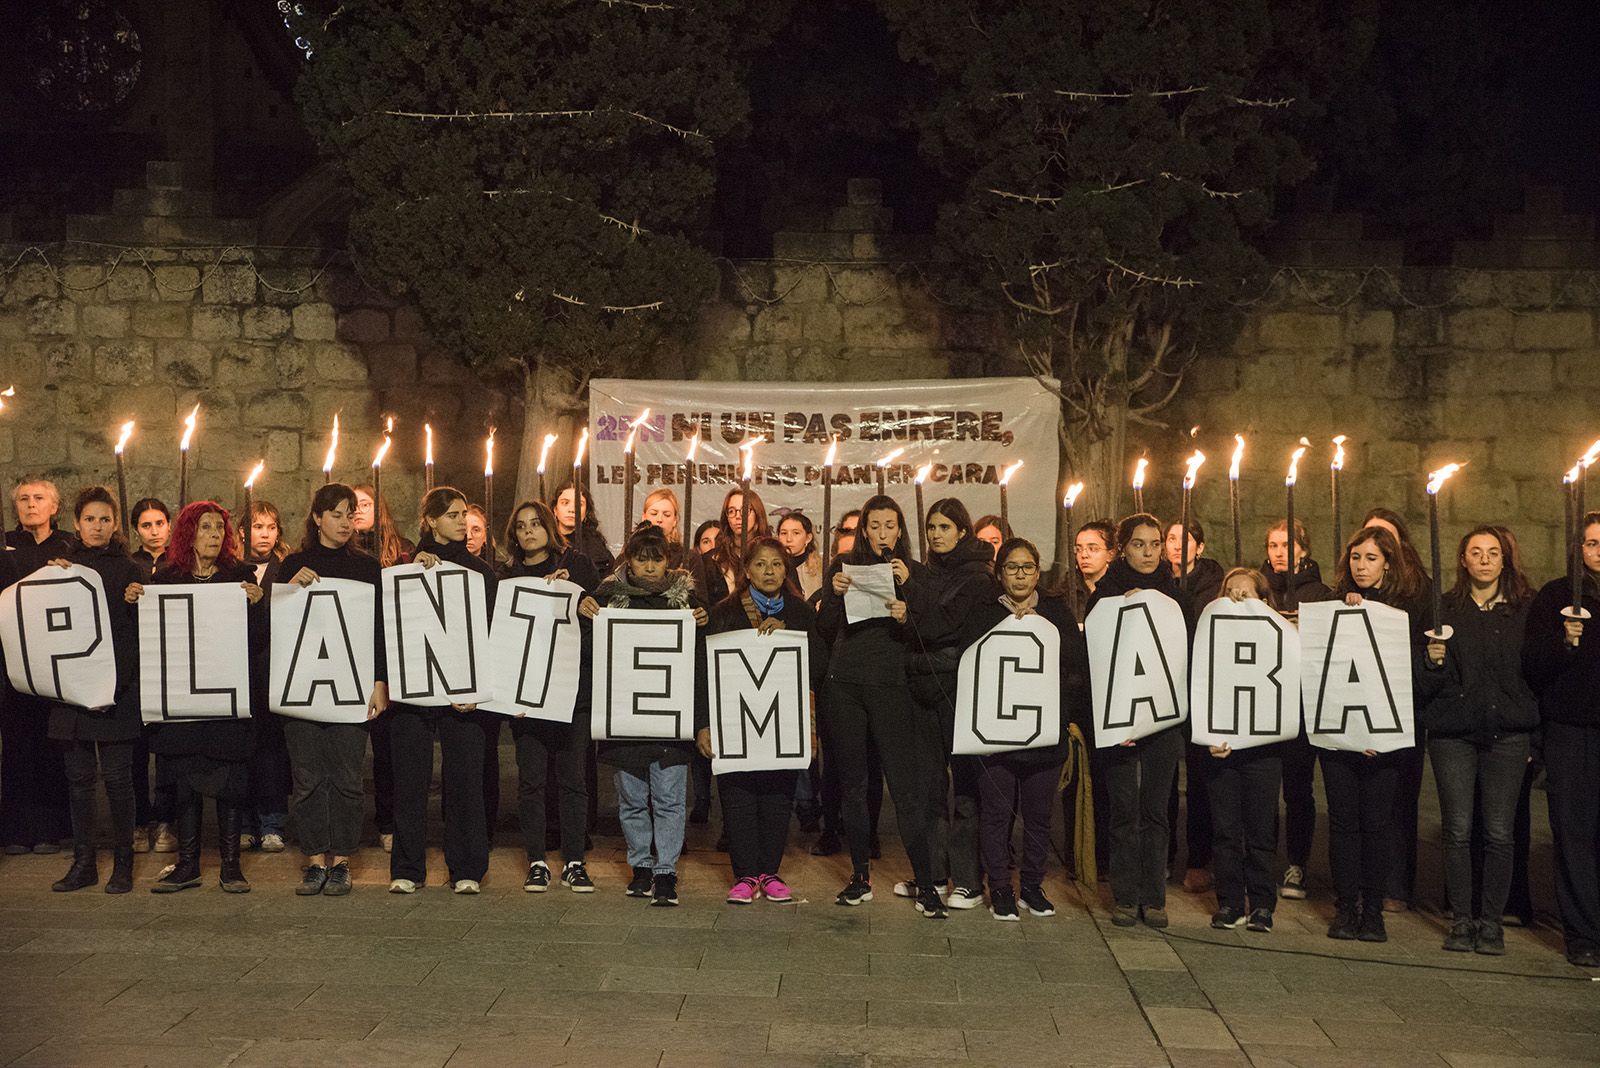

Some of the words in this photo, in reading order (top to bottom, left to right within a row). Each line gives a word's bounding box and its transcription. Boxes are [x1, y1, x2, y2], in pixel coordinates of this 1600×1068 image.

[596, 413, 666, 442] 25N
[672, 411, 712, 442] NI
[720, 411, 775, 444] UN
[784, 412, 852, 443] PAS
[859, 410, 1014, 447] ENRERE,
